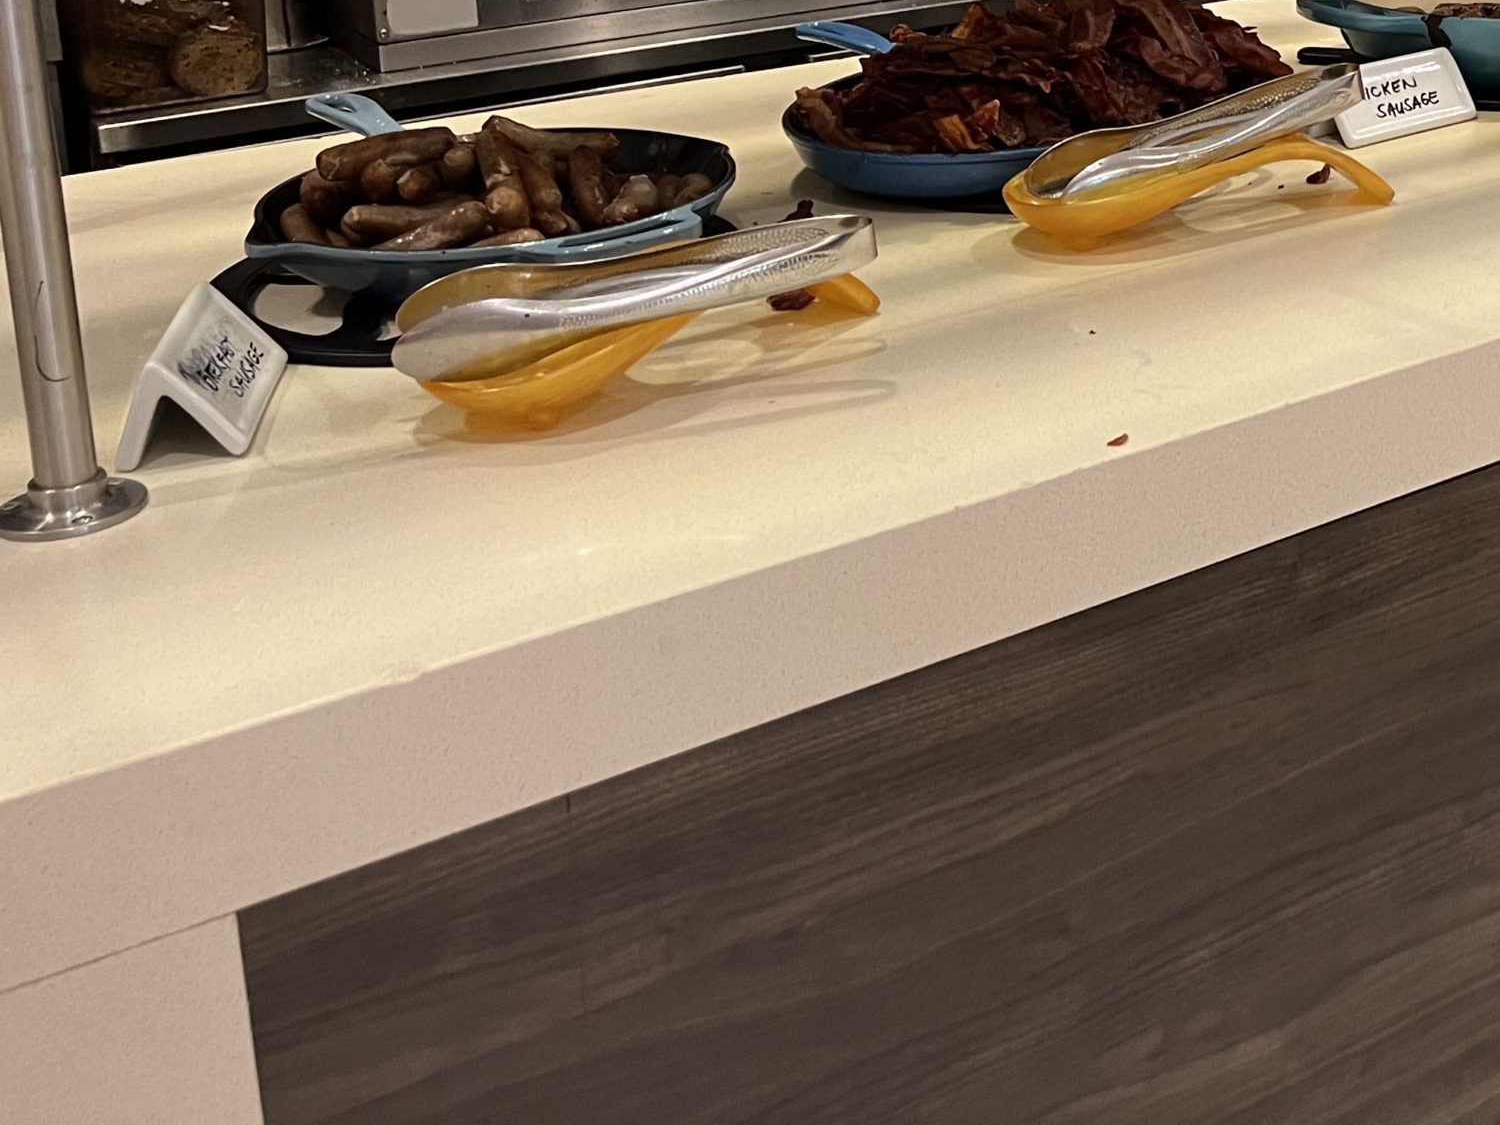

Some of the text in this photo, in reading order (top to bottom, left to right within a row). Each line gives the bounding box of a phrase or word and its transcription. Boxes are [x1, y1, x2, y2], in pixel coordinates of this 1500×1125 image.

[1363, 76, 1418, 101] ICKEN
[1376, 91, 1440, 118] SAUSAGE
[229, 341, 266, 398] SAUSAGE
